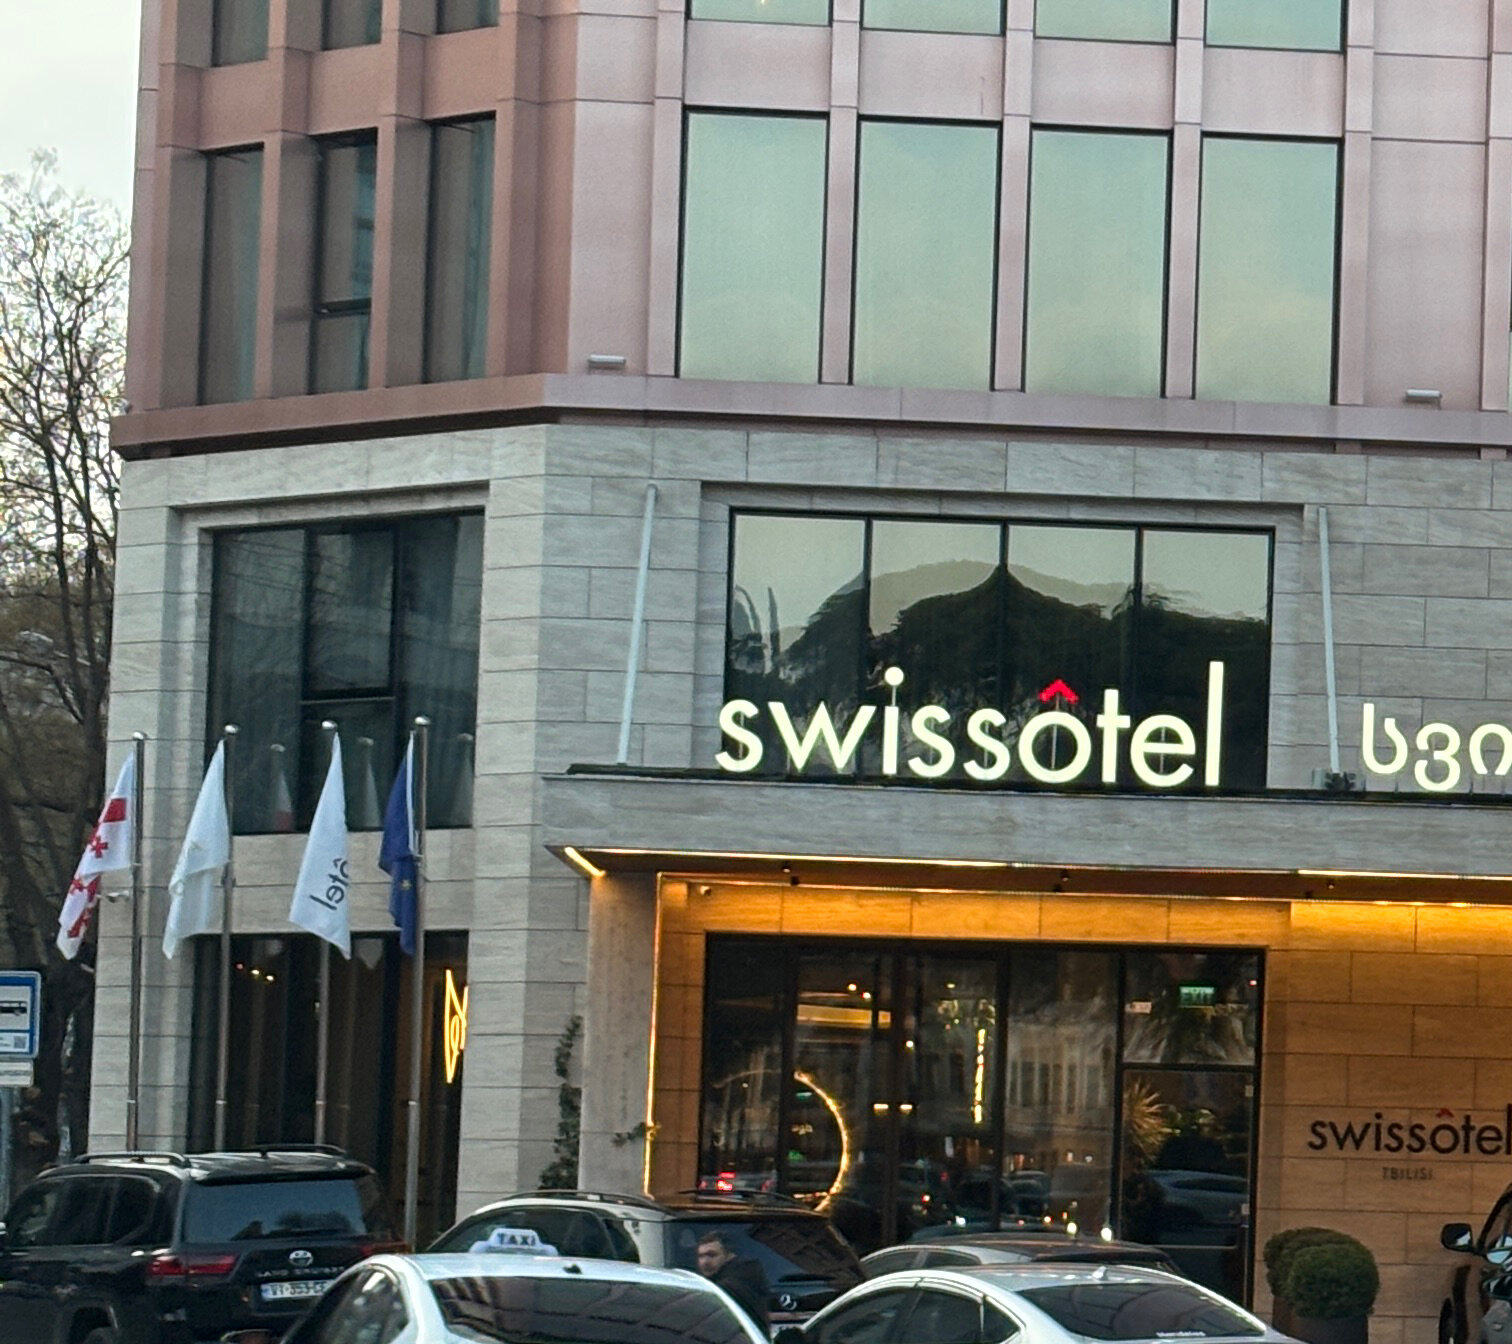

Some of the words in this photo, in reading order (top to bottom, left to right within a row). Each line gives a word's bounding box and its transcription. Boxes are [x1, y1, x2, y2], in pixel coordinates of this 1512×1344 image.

[714, 660, 1225, 788] swissôtel
[1382, 1166, 1434, 1181] TBILISI
[496, 1232, 537, 1245] TAXI
